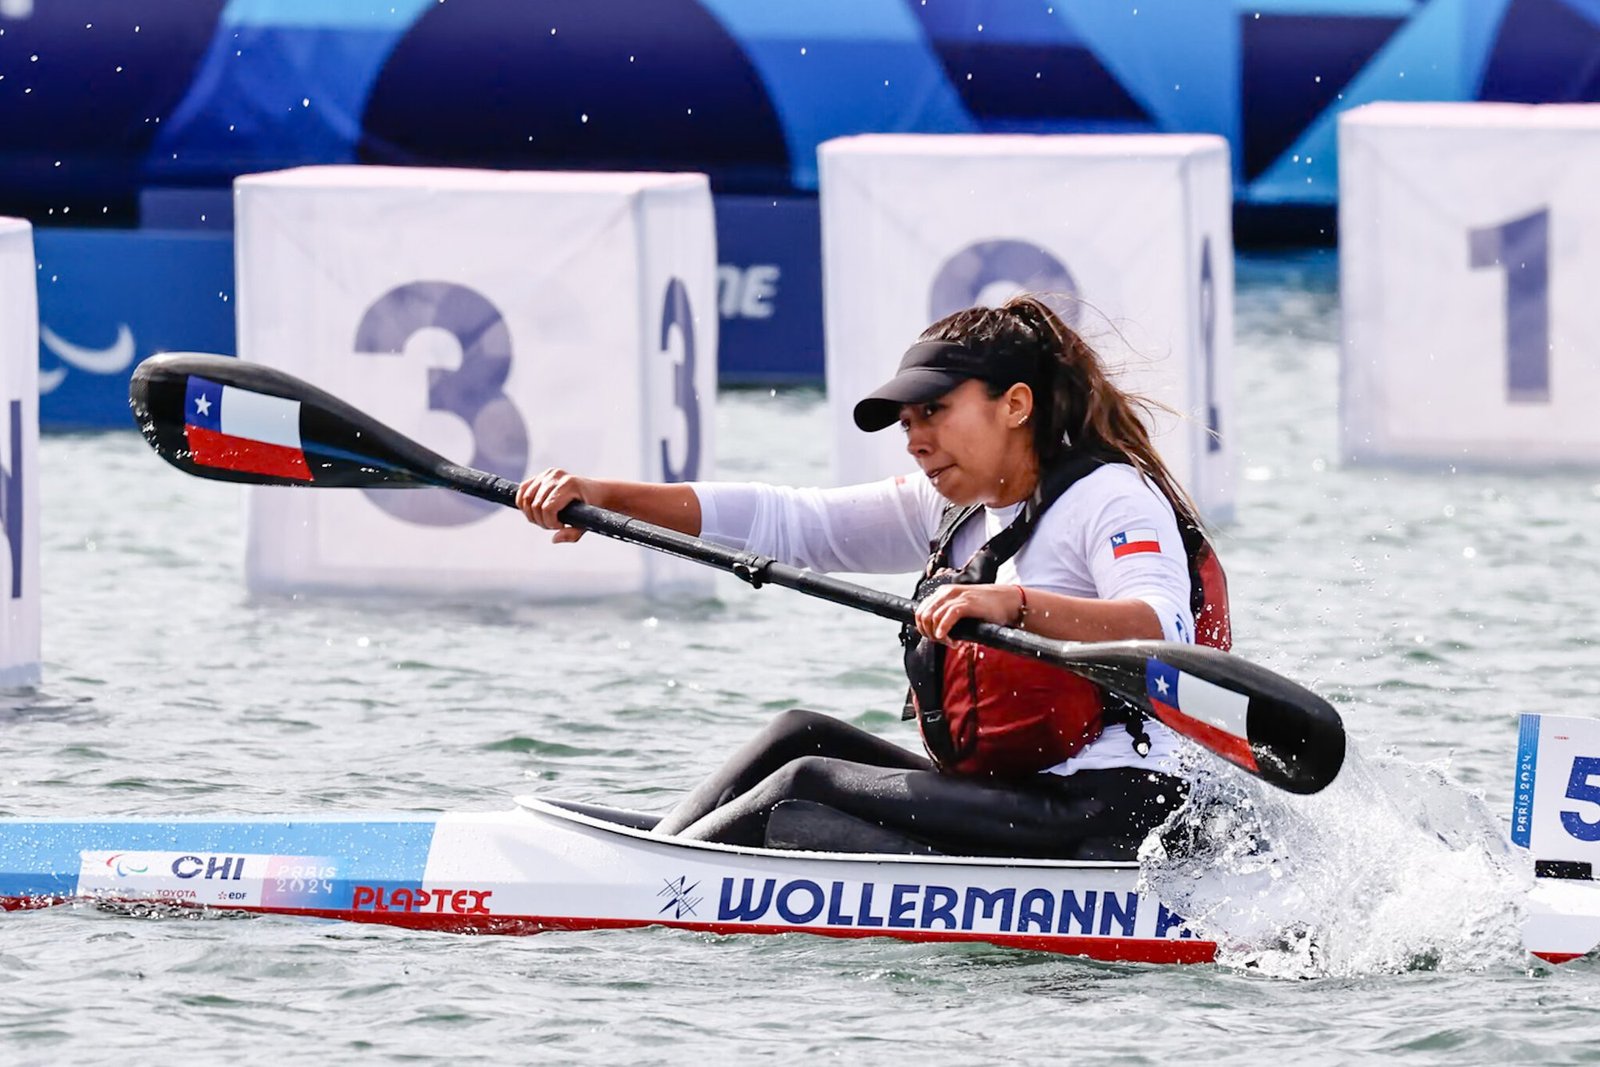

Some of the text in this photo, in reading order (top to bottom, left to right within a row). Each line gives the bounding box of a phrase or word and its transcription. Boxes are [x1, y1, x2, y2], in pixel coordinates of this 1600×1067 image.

[1467, 206, 1551, 403] 1
[353, 280, 529, 528] 3
[661, 276, 701, 484] 3
[1517, 754, 1532, 832] PARIS 2024
[1560, 755, 1600, 842] 5
[157, 889, 197, 899] TOYOTA
[171, 855, 246, 881] CHI
[276, 865, 337, 878] PARIS
[276, 878, 333, 895] 2024
[717, 877, 1139, 937] WOLLERMANN
